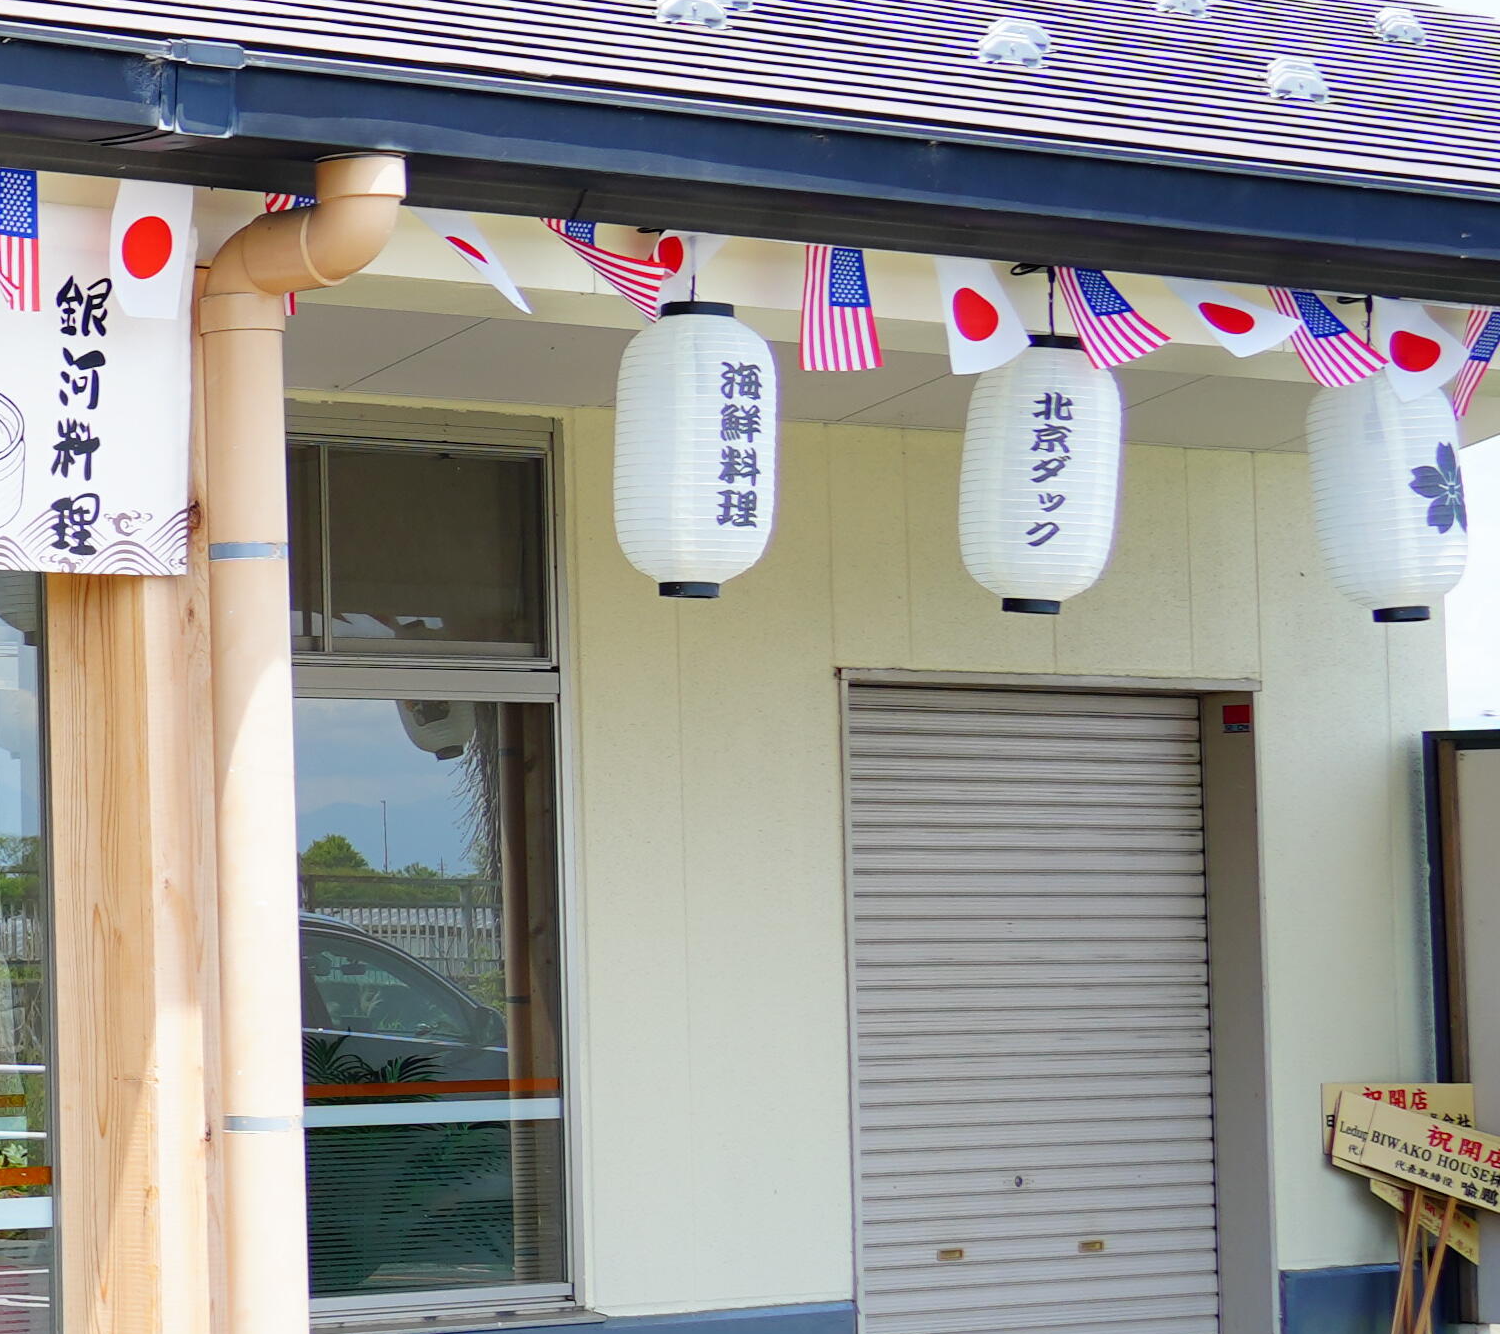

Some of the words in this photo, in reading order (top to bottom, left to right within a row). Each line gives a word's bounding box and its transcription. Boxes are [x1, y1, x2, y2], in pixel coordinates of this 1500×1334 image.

[50, 275, 112, 556] 銀河料理
[716, 361, 763, 529] 海鮮料理
[1025, 391, 1074, 547] 北京ダック
[1370, 1130, 1433, 1162] BIWAKO
